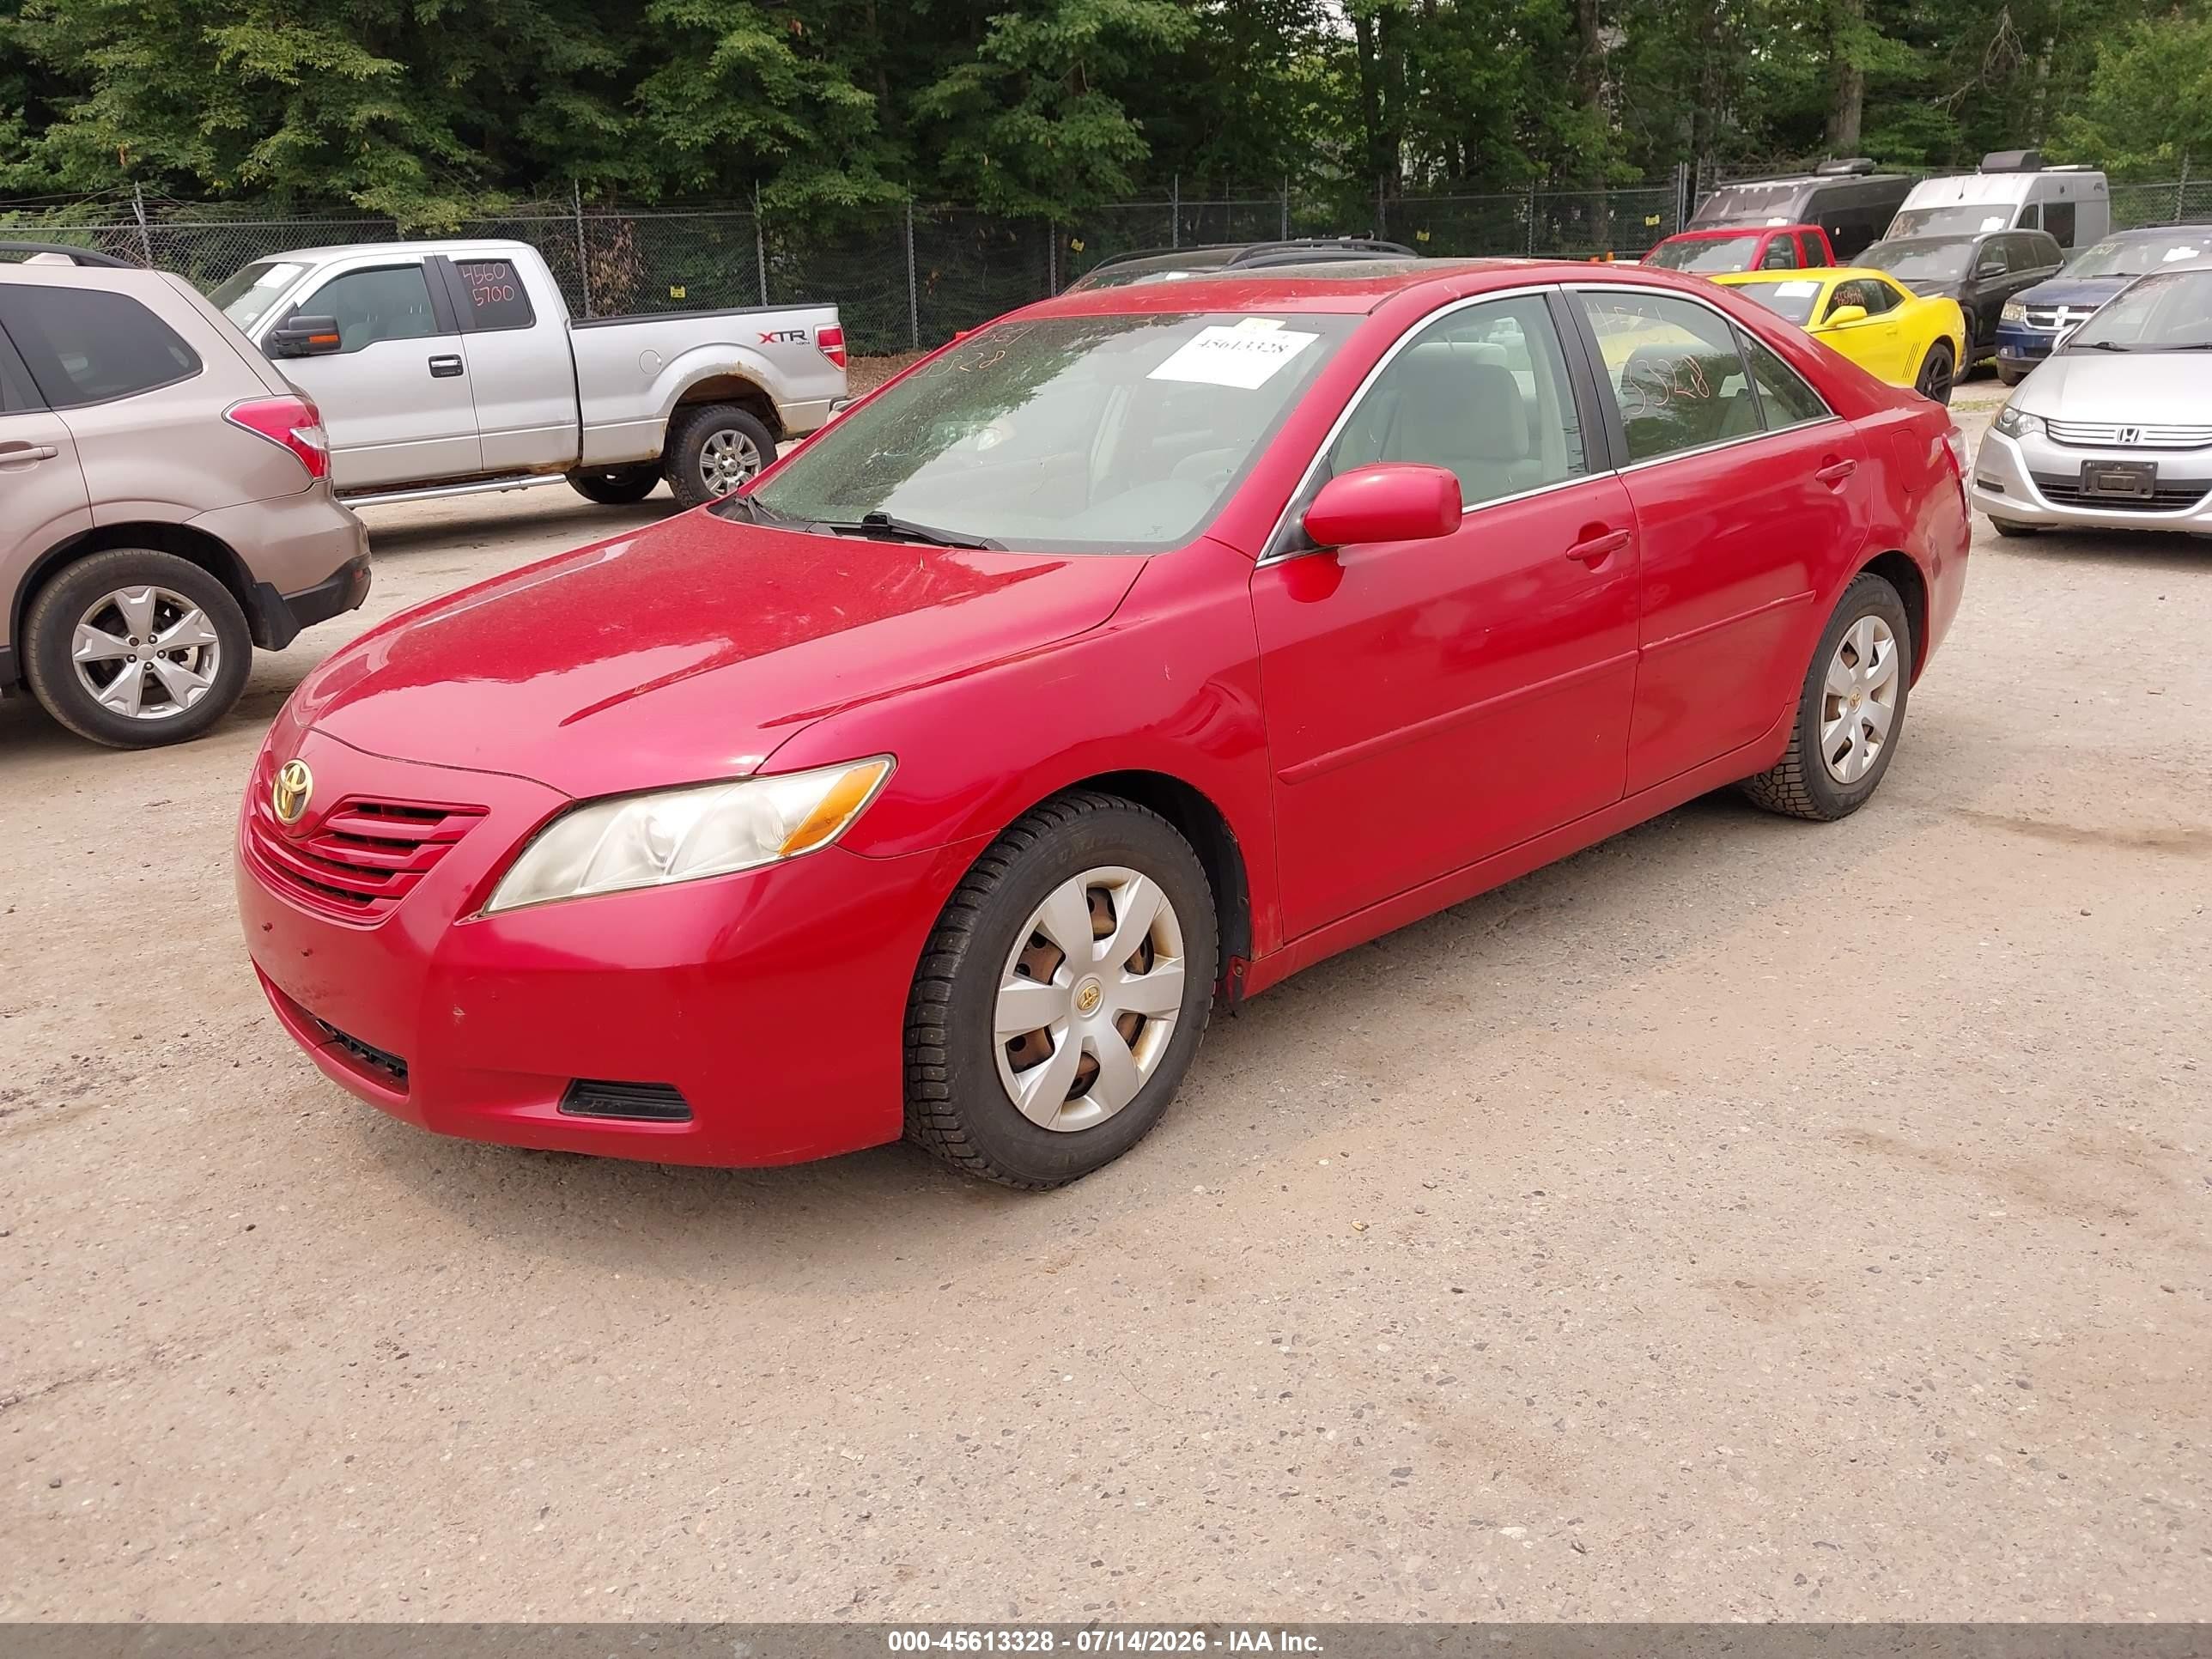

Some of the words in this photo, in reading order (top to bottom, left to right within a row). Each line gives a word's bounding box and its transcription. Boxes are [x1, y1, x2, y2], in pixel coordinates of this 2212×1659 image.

[461, 263, 506, 286] 4560
[472, 285, 514, 307] 5700
[756, 330, 808, 344] XTR
